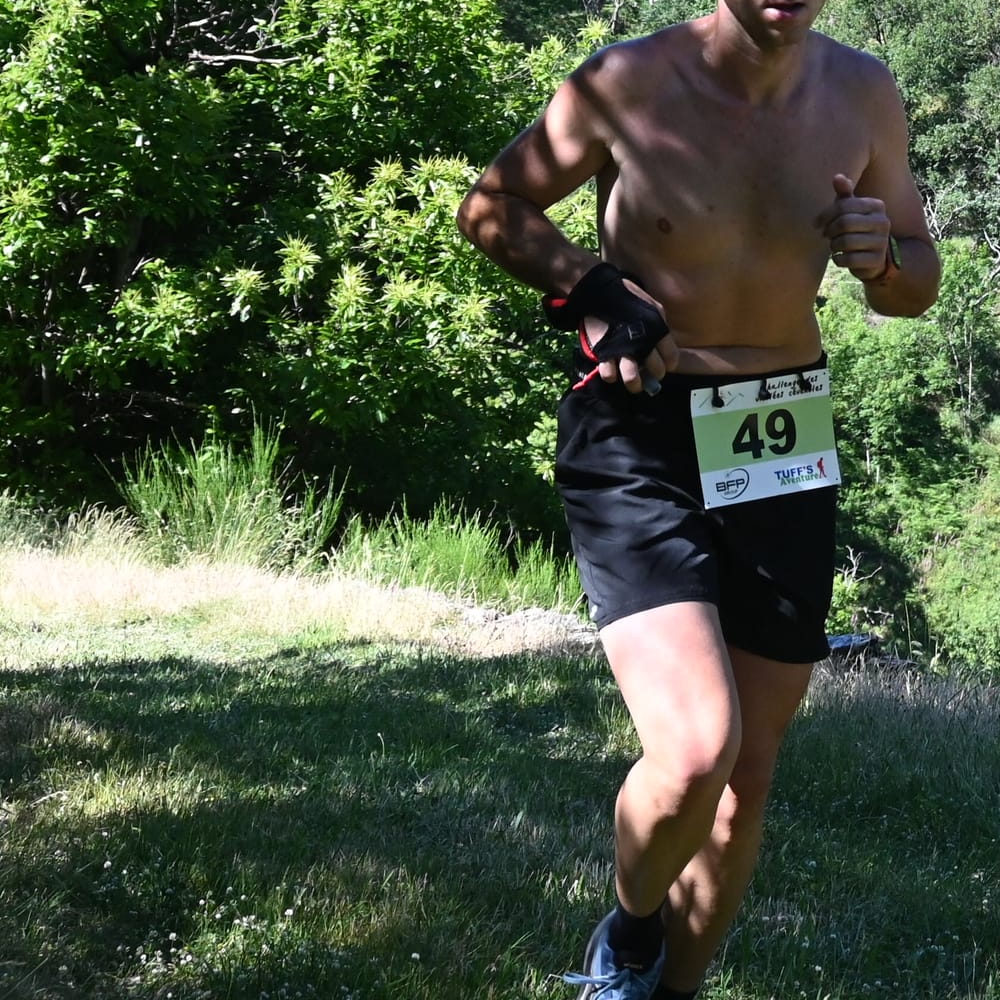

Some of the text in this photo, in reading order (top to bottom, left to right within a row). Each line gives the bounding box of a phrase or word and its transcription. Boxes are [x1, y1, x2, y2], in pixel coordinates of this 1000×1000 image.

[731, 408, 797, 460] 49
[774, 464, 814, 481] TUFF'S
[780, 473, 819, 487] Aventure
[715, 478, 746, 493] BFP
